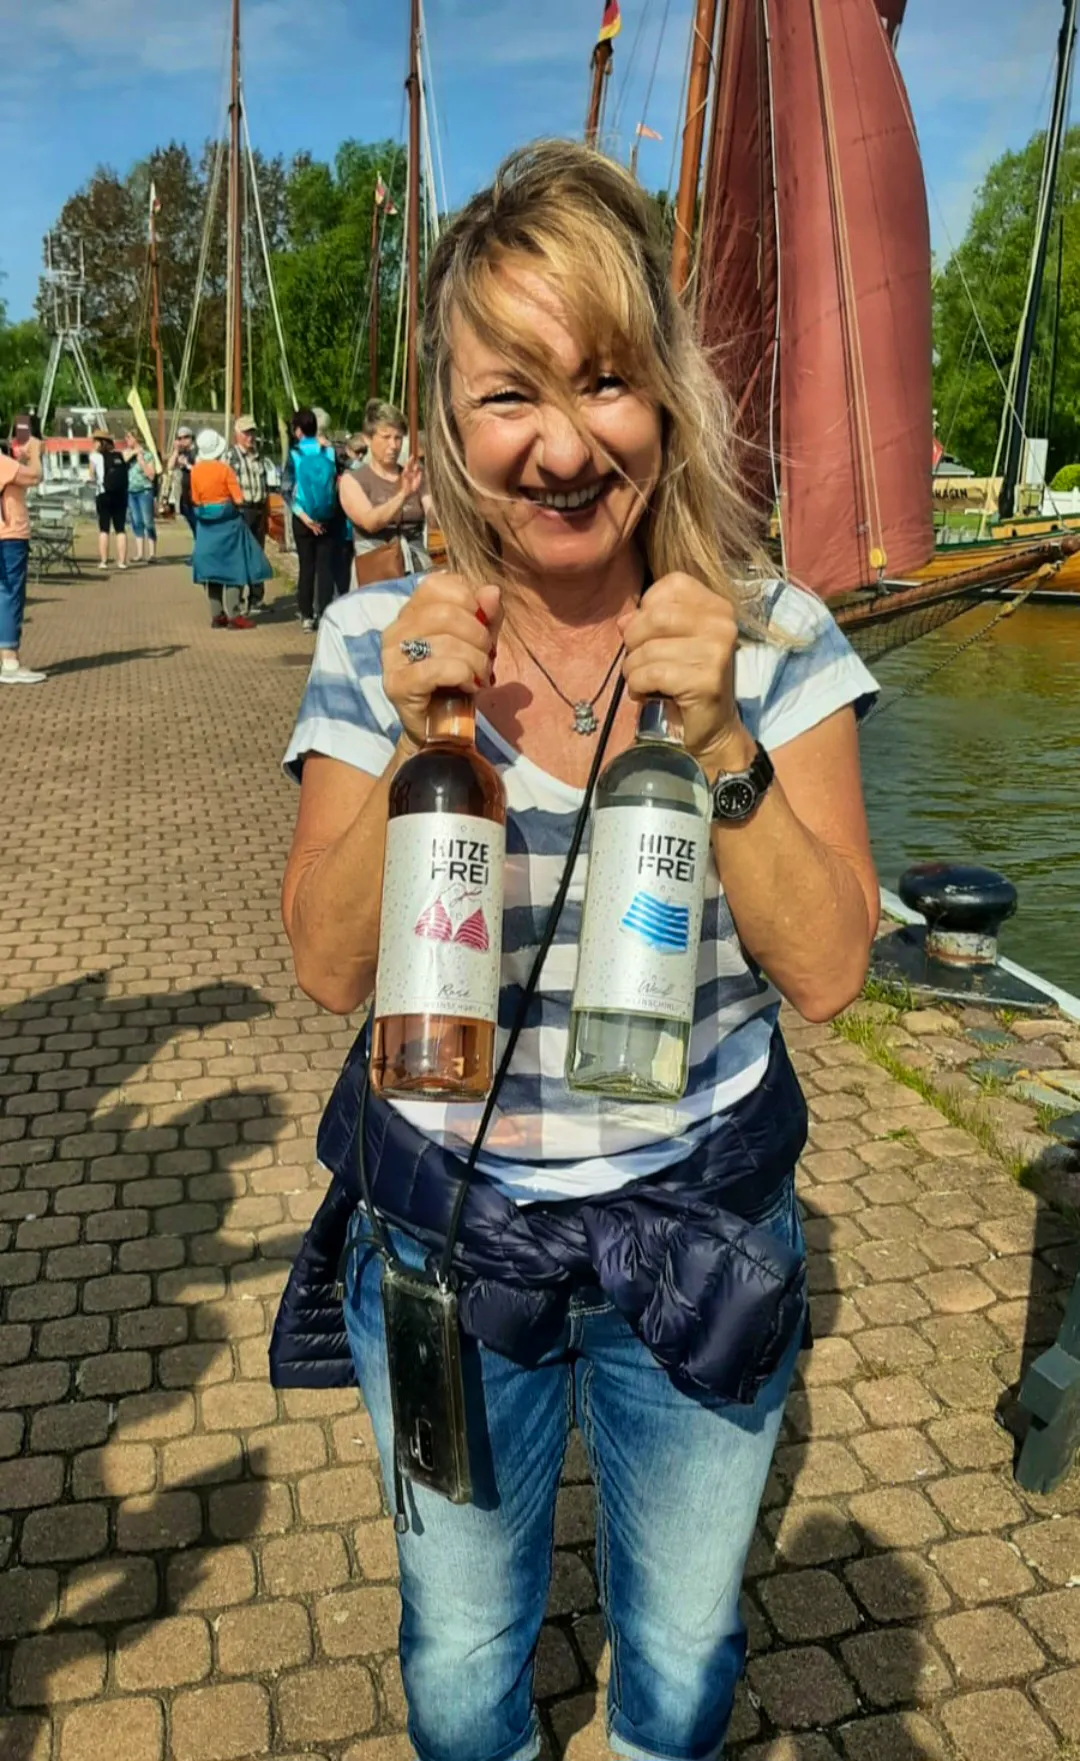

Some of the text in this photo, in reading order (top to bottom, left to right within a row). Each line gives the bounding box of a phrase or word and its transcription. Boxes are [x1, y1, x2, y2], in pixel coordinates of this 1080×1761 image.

[638, 833, 696, 861] HITZE
[431, 860, 489, 886] FREI
[638, 855, 695, 883] FREI
